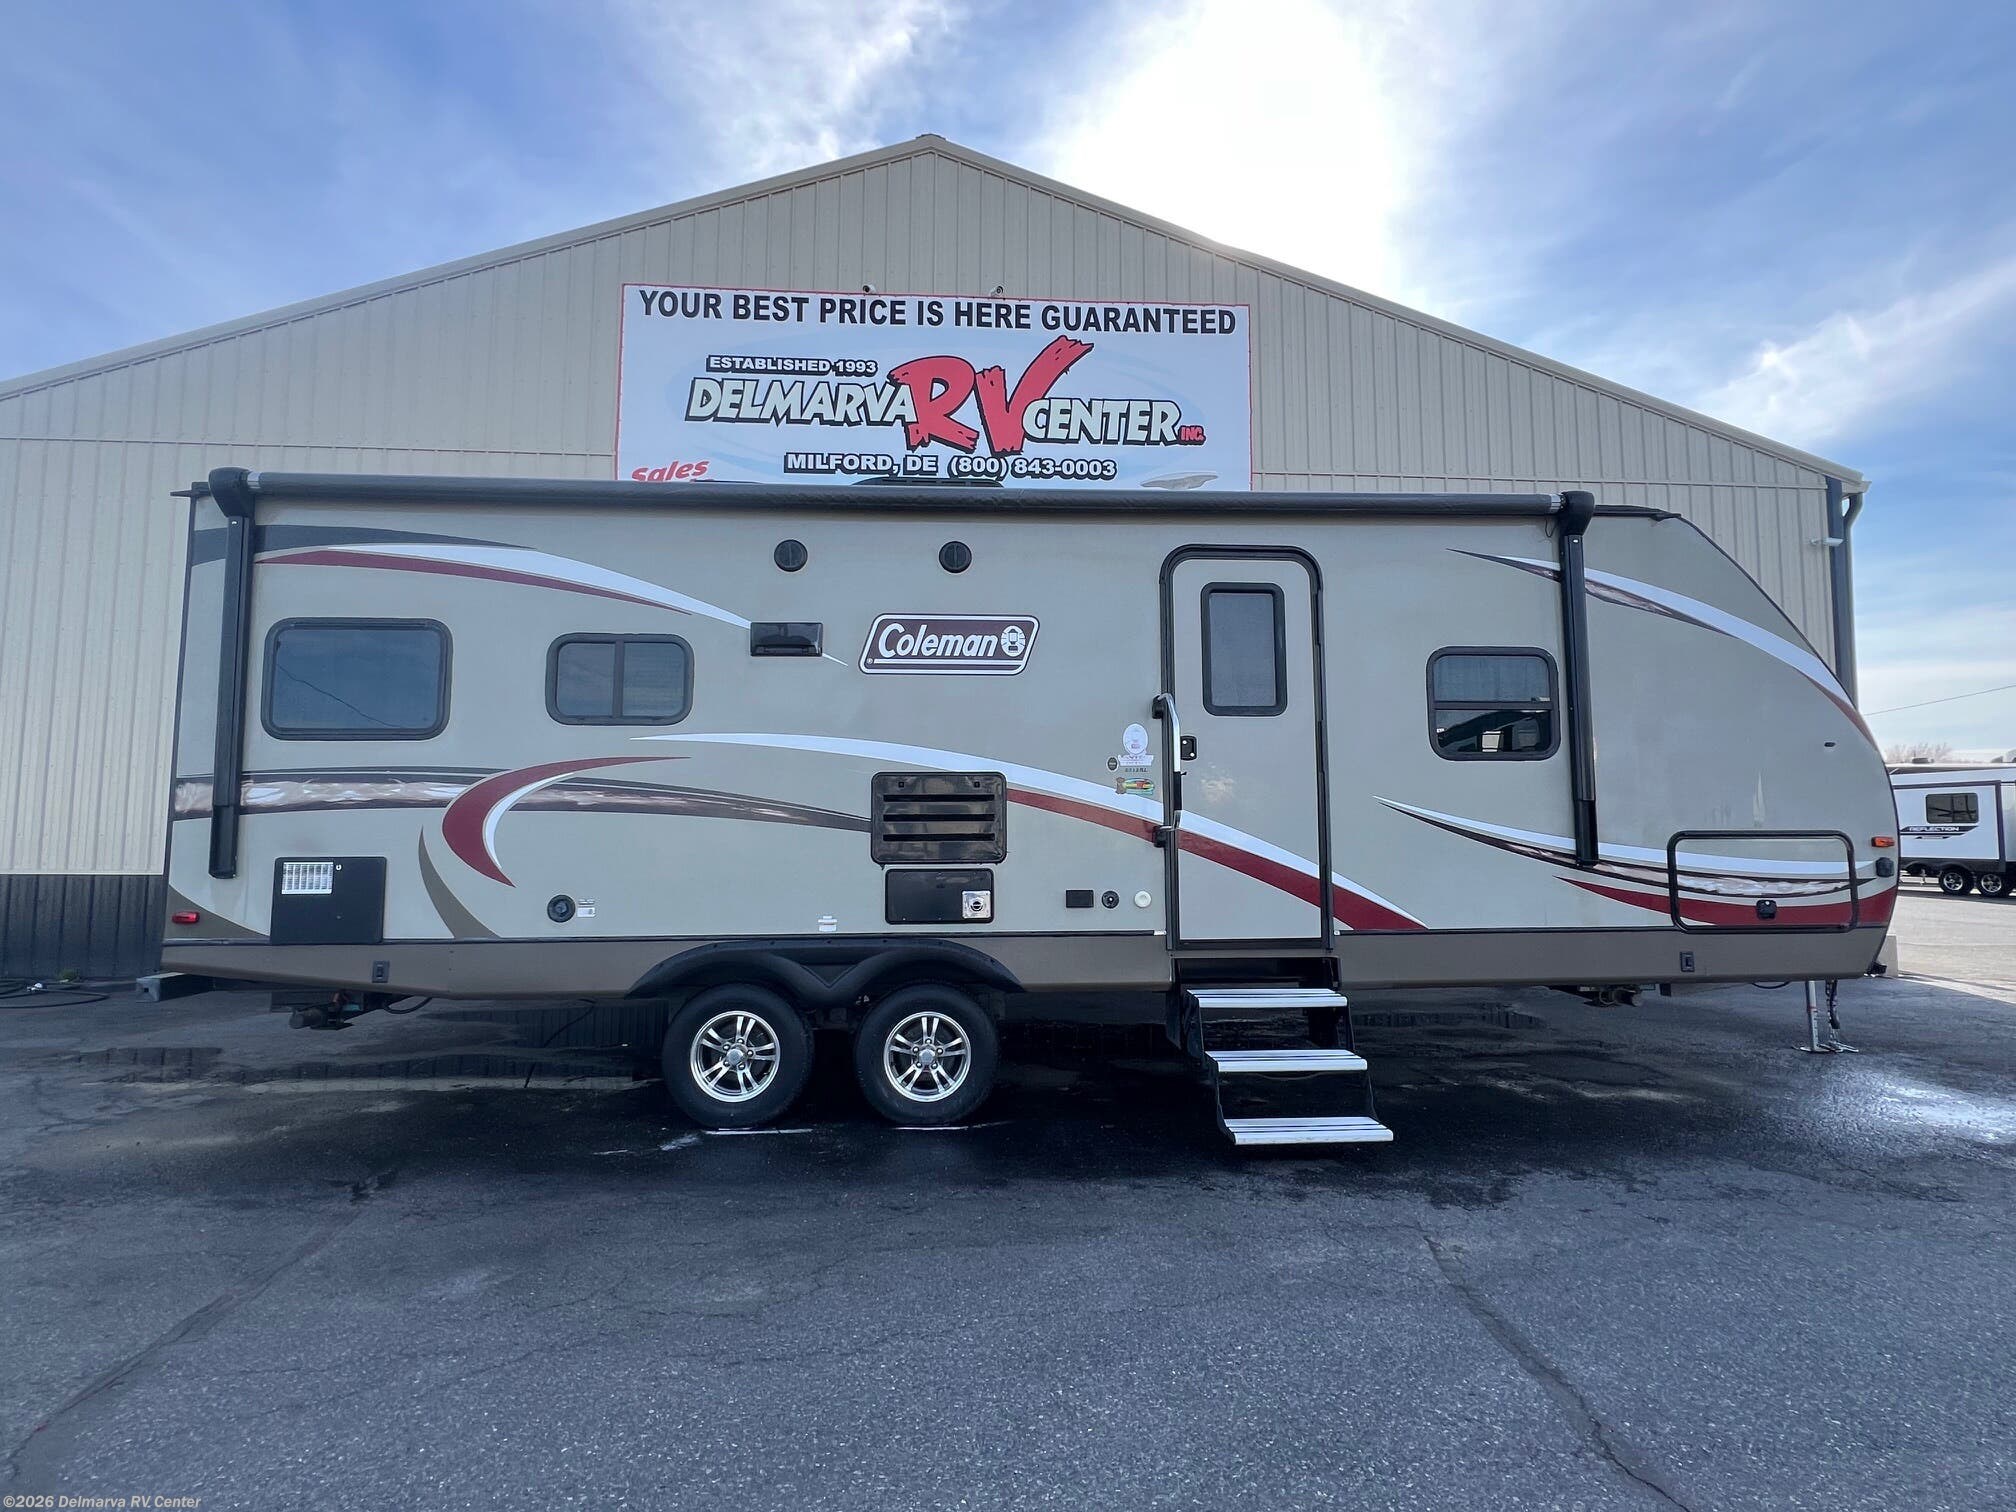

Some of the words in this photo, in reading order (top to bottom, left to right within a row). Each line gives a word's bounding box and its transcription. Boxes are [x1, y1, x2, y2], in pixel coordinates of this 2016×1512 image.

[639, 290, 722, 319] YOUR
[733, 294, 809, 323] BEST
[820, 298, 906, 325] PRICE
[917, 300, 944, 326] IS
[954, 301, 1031, 329] HERE
[1041, 305, 1236, 335] GUARANTEED
[708, 356, 831, 373] ESTABLISHED
[835, 359, 878, 373] 1993
[686, 378, 917, 426] DELMARVA
[887, 335, 1094, 455] RV
[1021, 398, 1183, 445] CENTER
[1179, 425, 1206, 442] INC.
[631, 460, 710, 482] sales
[786, 453, 900, 475] MILFORD,
[905, 455, 938, 473] DE
[949, 455, 1010, 478] (800)
[1013, 460, 1118, 477] 843-0003
[878, 622, 999, 659] Coleman
